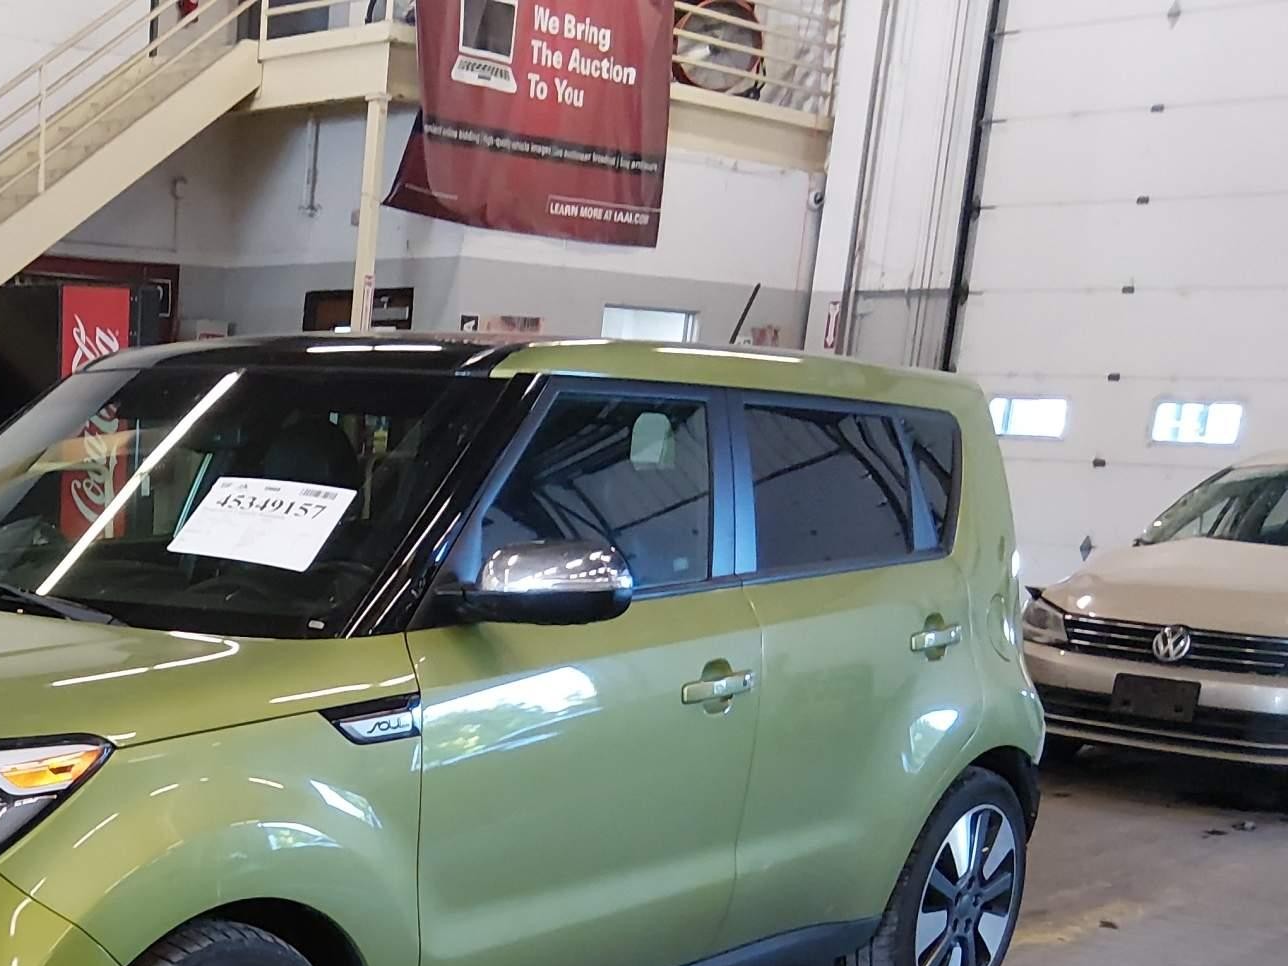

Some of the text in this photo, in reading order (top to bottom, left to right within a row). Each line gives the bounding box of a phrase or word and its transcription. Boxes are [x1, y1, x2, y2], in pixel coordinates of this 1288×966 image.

[534, 4, 611, 52] We Bring
[531, 39, 637, 85] The Auction
[527, 72, 585, 108] To You
[550, 202, 579, 217] LEARN
[579, 206, 604, 220] MORE
[603, 209, 613, 221] AT
[216, 494, 328, 520] 45349157
